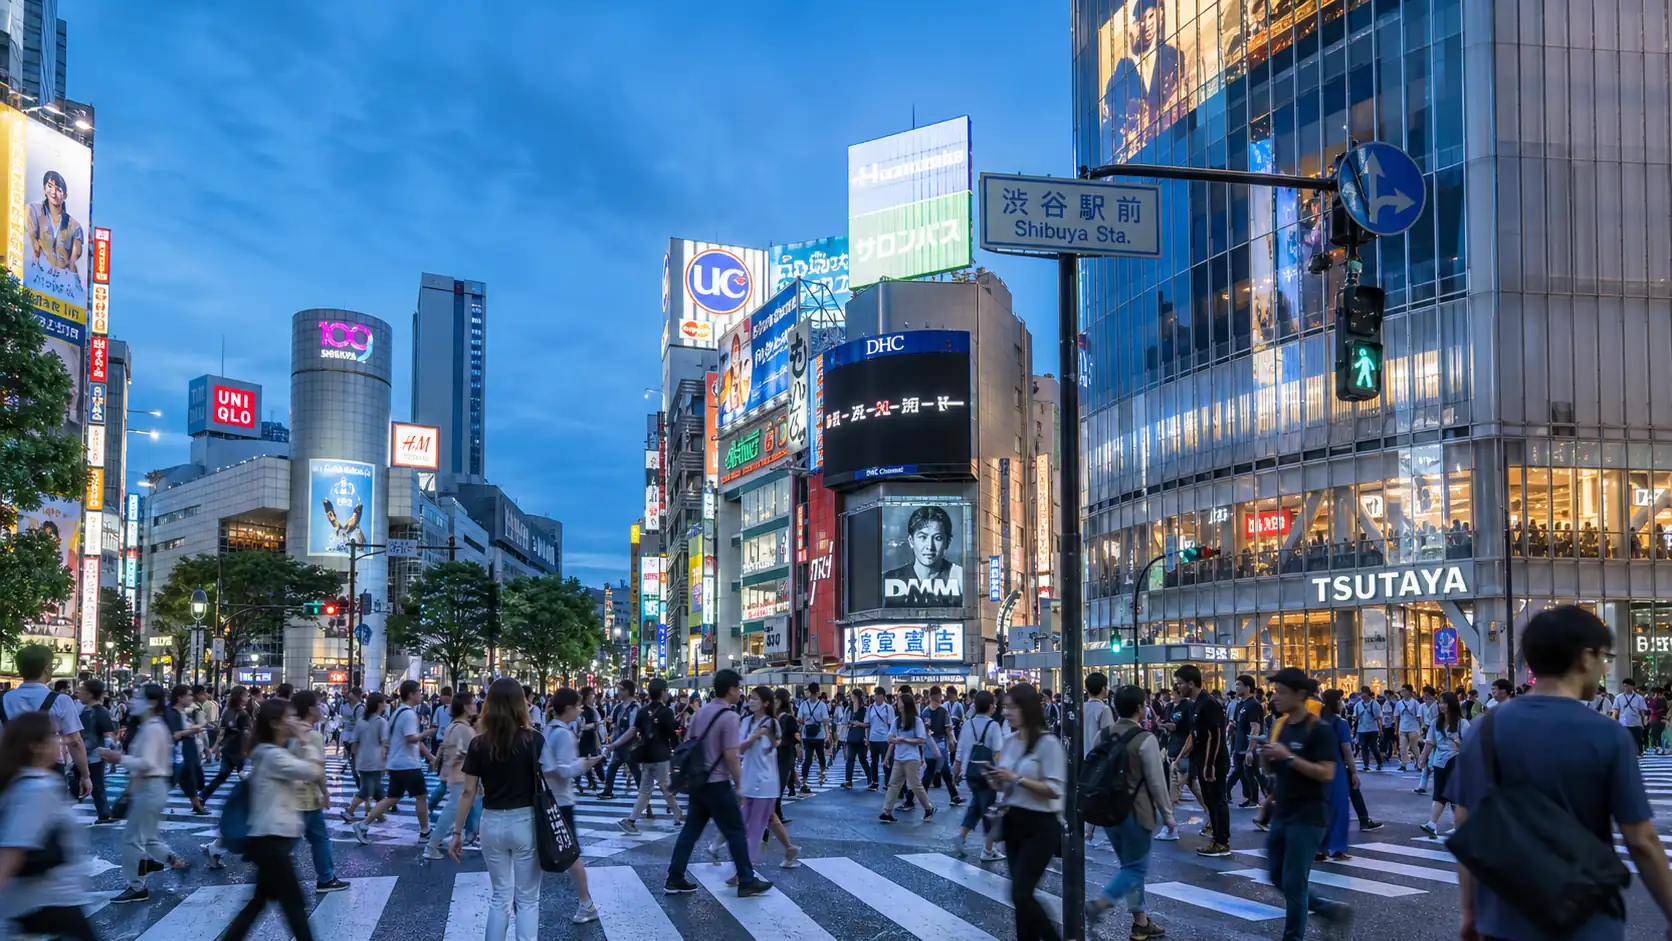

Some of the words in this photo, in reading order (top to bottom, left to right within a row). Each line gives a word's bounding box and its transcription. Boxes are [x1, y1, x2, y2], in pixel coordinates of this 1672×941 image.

[1002, 188, 1142, 224] 渋谷駅前
[1014, 219, 1088, 244] Shibuya
[1097, 225, 1131, 244] Sta.
[693, 264, 746, 299] UC
[866, 335, 904, 355] DHC
[218, 389, 249, 409] UNI
[217, 406, 251, 424] QLO
[885, 578, 960, 597] DMM
[1312, 566, 1467, 602] TSUTAYA
